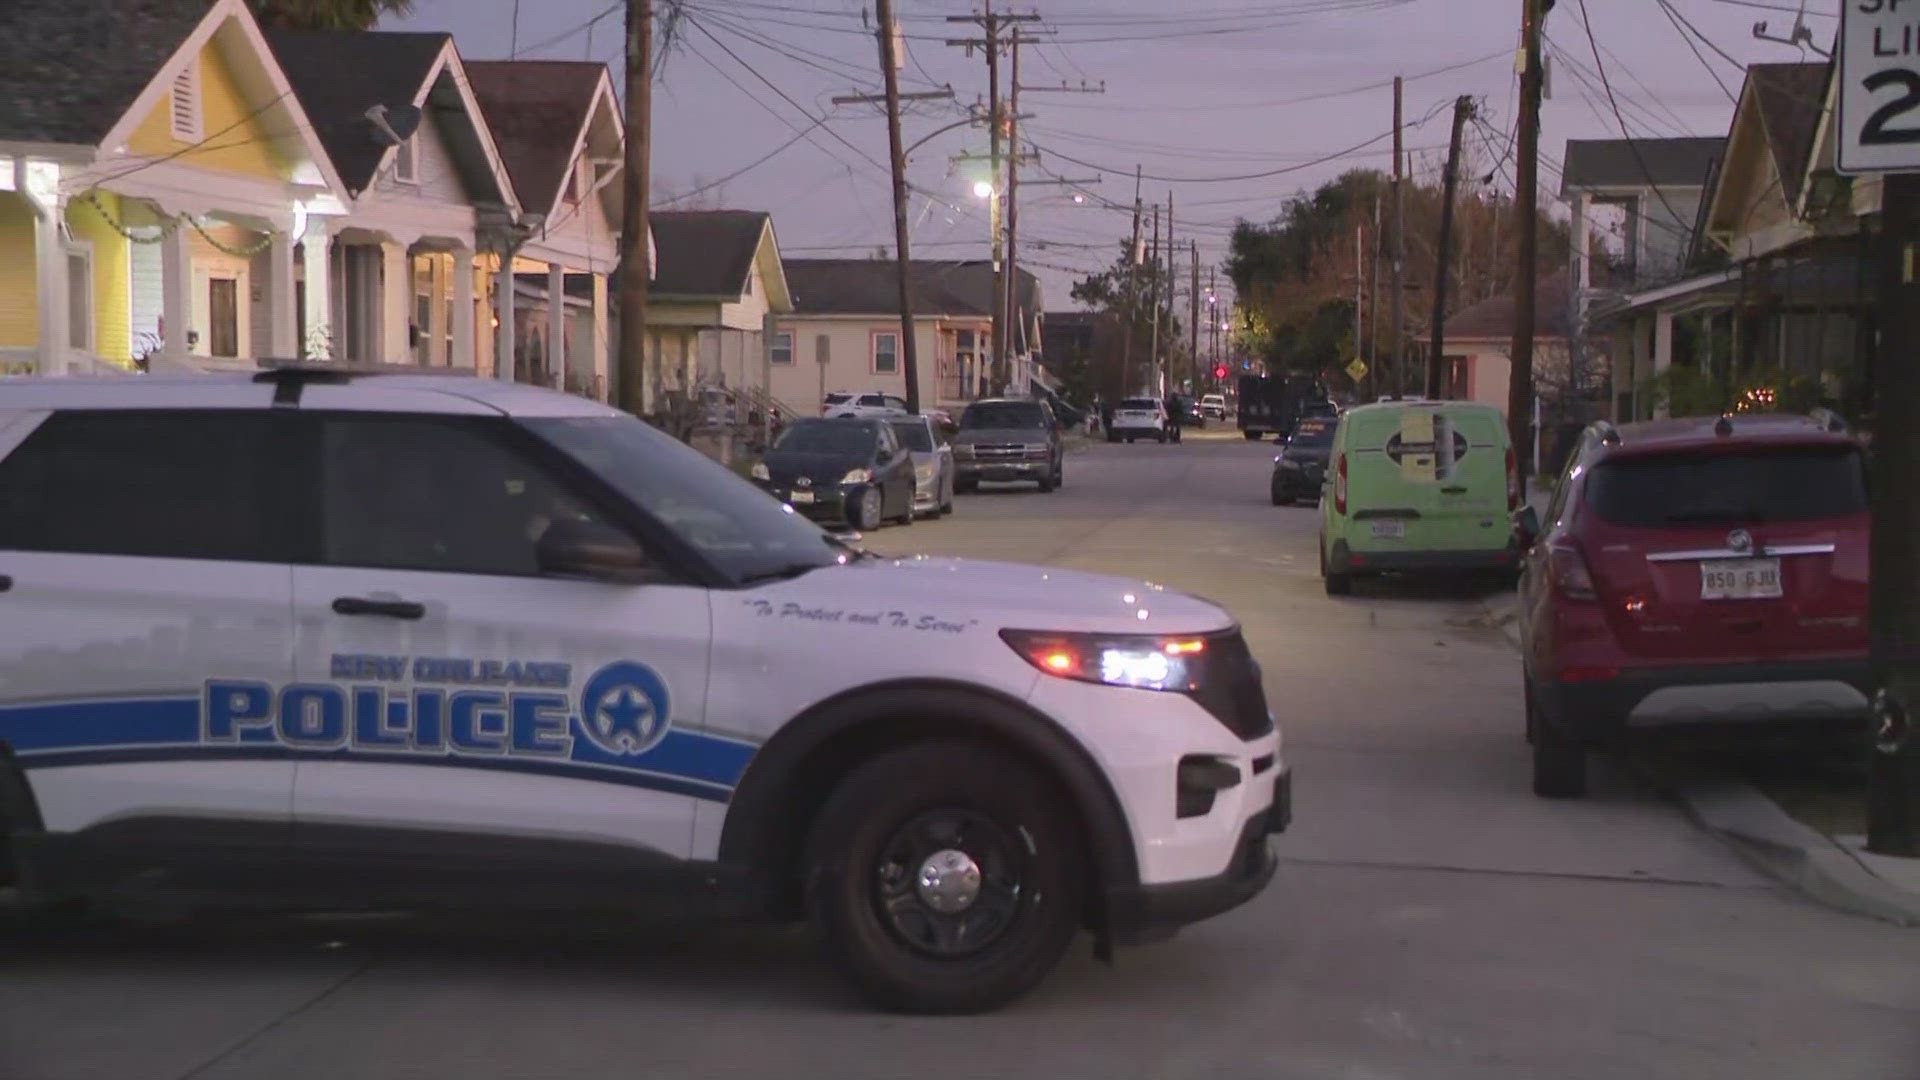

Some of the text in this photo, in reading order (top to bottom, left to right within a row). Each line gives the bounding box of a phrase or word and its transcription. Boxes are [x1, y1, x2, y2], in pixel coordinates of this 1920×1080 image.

[1874, 25, 1920, 57] LI
[887, 611, 909, 627] To
[331, 653, 572, 688] NEW ORLEANS
[204, 679, 572, 758] POLICE
